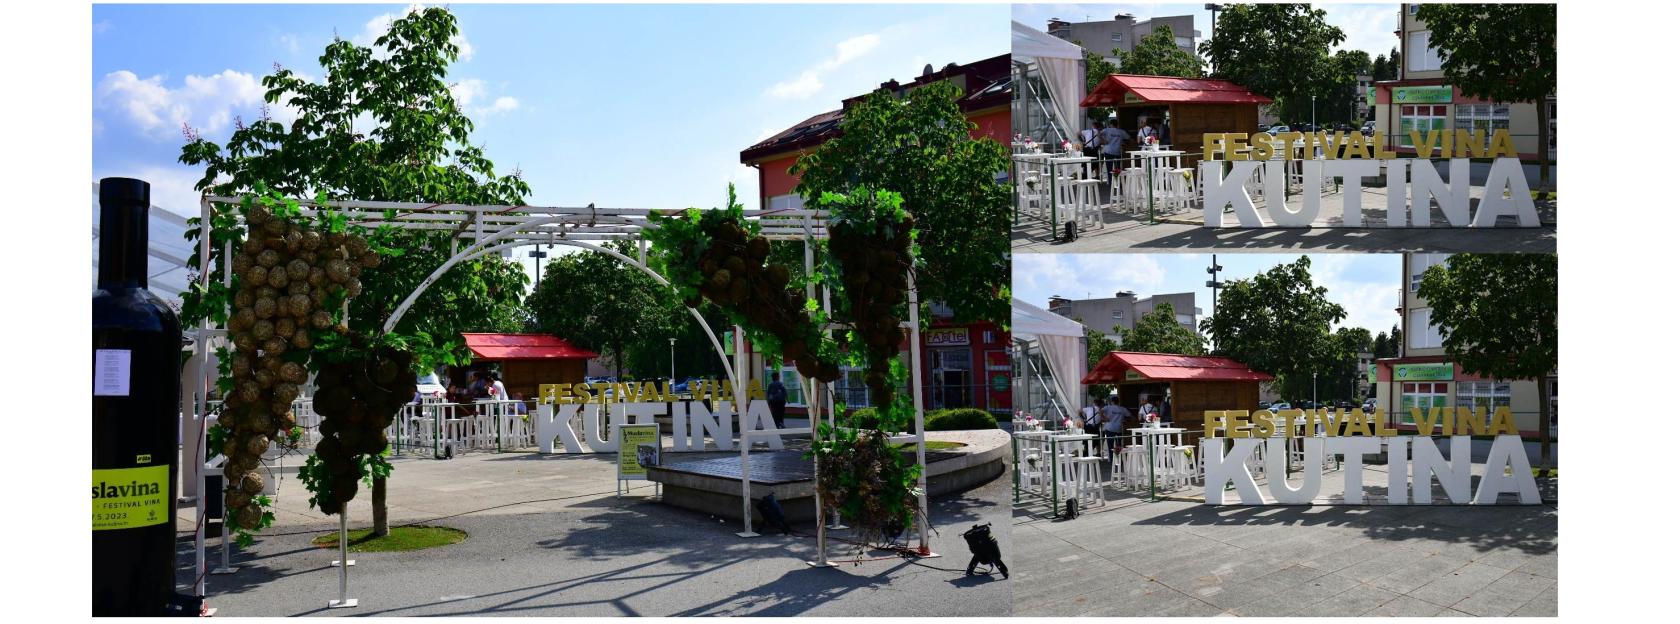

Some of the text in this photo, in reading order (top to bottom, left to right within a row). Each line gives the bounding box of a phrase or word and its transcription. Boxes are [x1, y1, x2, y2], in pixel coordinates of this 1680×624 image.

[1204, 129, 1517, 161] FESTIVAL VINA
[1203, 157, 1541, 228] KUTINA
[540, 380, 766, 404] FESTIVAL VINA
[539, 399, 784, 454] KUTINA
[1205, 407, 1519, 438] FESTIVAL VINA
[1204, 435, 1542, 505] KUTINA
[103, 498, 161, 509] FESTIVAL VINA
